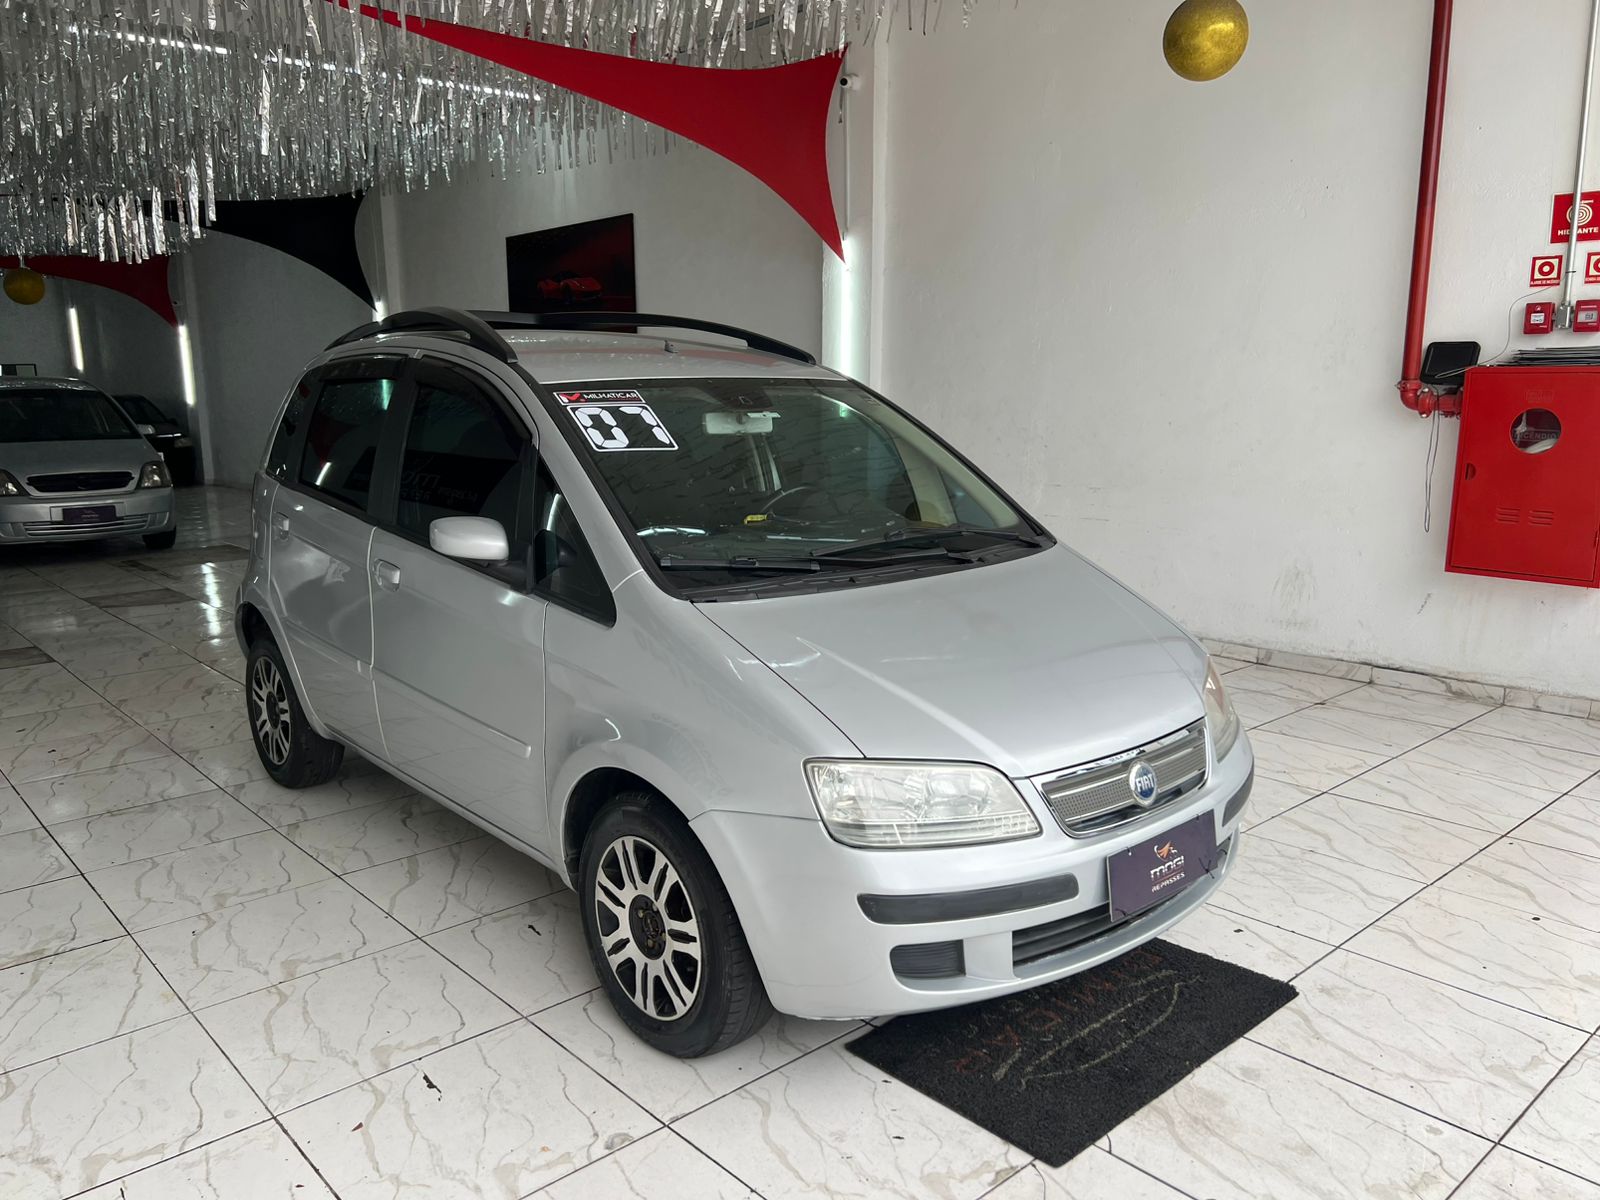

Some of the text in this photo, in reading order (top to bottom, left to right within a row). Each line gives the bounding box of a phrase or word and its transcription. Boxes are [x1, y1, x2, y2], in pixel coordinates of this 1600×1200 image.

[1557, 227, 1599, 236] HIDANTE
[575, 407, 670, 448] 07
[1136, 774, 1154, 792] FIAT
